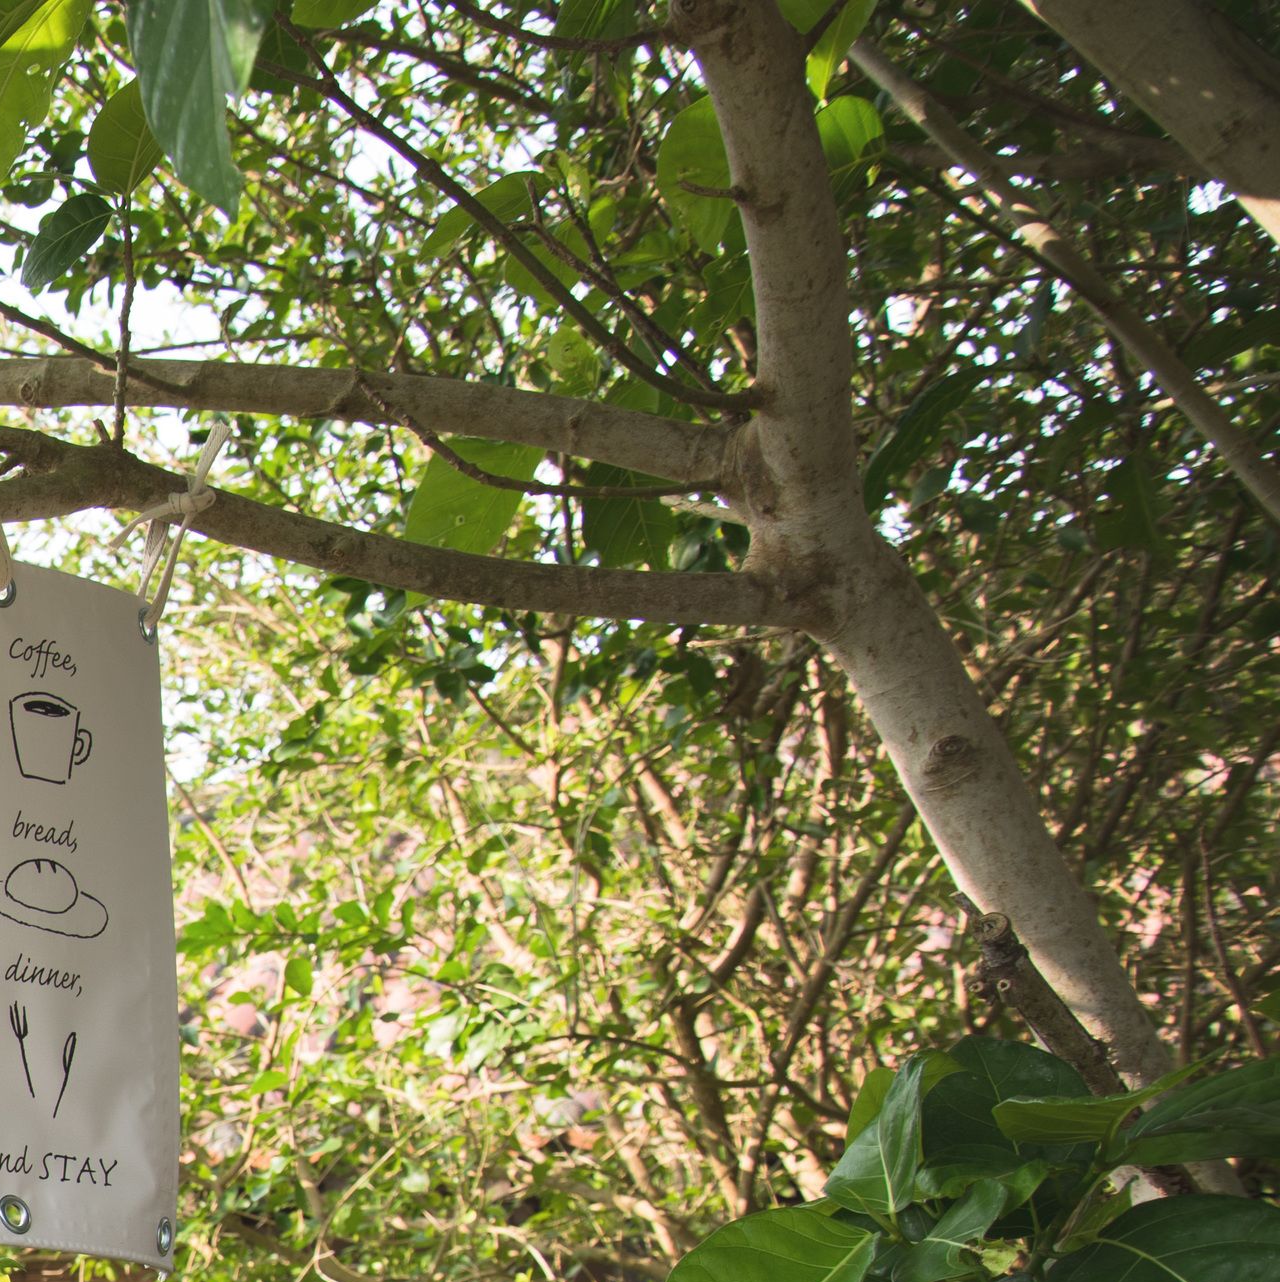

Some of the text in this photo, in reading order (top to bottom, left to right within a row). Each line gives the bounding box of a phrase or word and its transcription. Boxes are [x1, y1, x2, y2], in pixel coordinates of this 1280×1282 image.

[8, 637, 78, 678] Coffee,
[12, 810, 78, 854] bread,
[4, 953, 83, 997] dinner,
[38, 1152, 119, 1187] STAY
